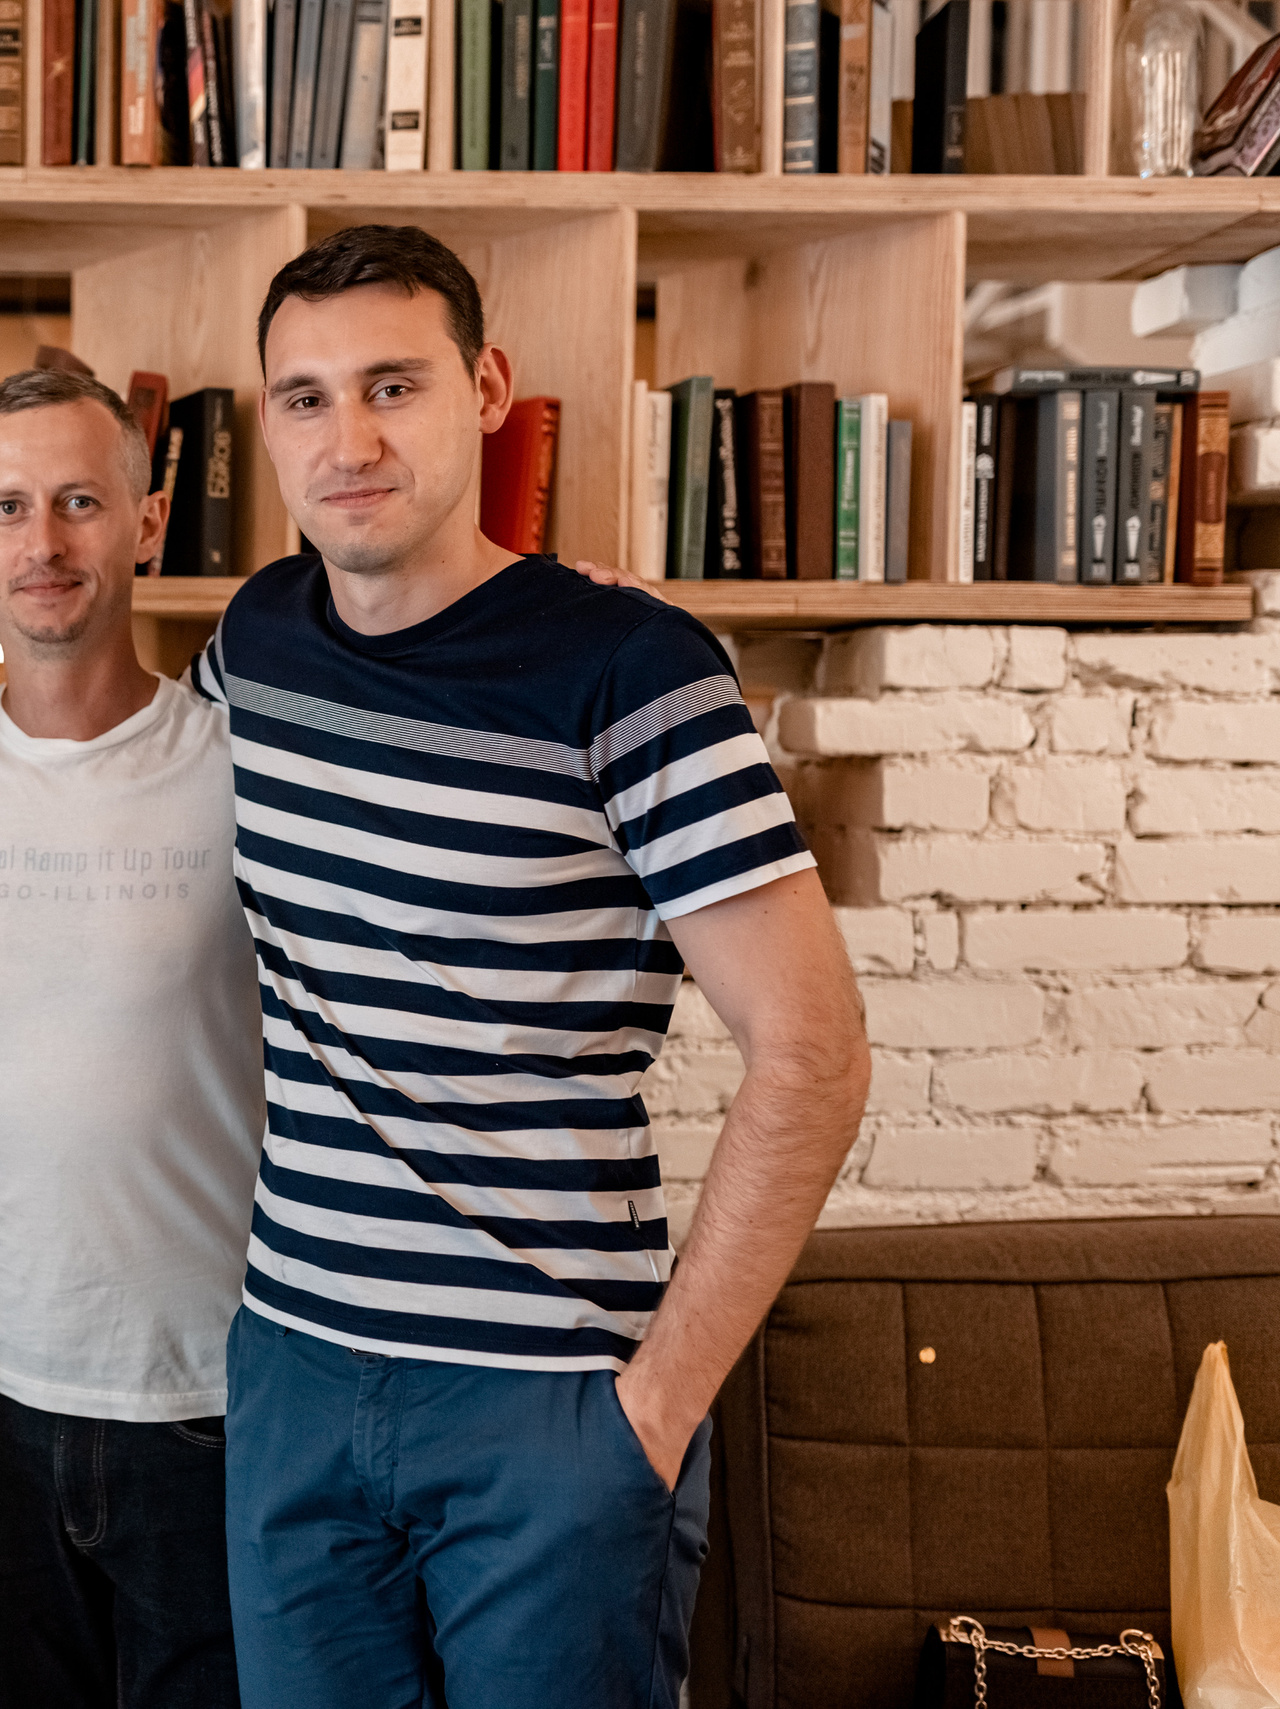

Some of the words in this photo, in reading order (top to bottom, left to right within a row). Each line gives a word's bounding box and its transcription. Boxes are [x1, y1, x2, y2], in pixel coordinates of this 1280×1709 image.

[24, 847, 88, 877] Ramp
[98, 845, 115, 872] it
[123, 847, 153, 875] Up
[161, 846, 210, 870] Tour
